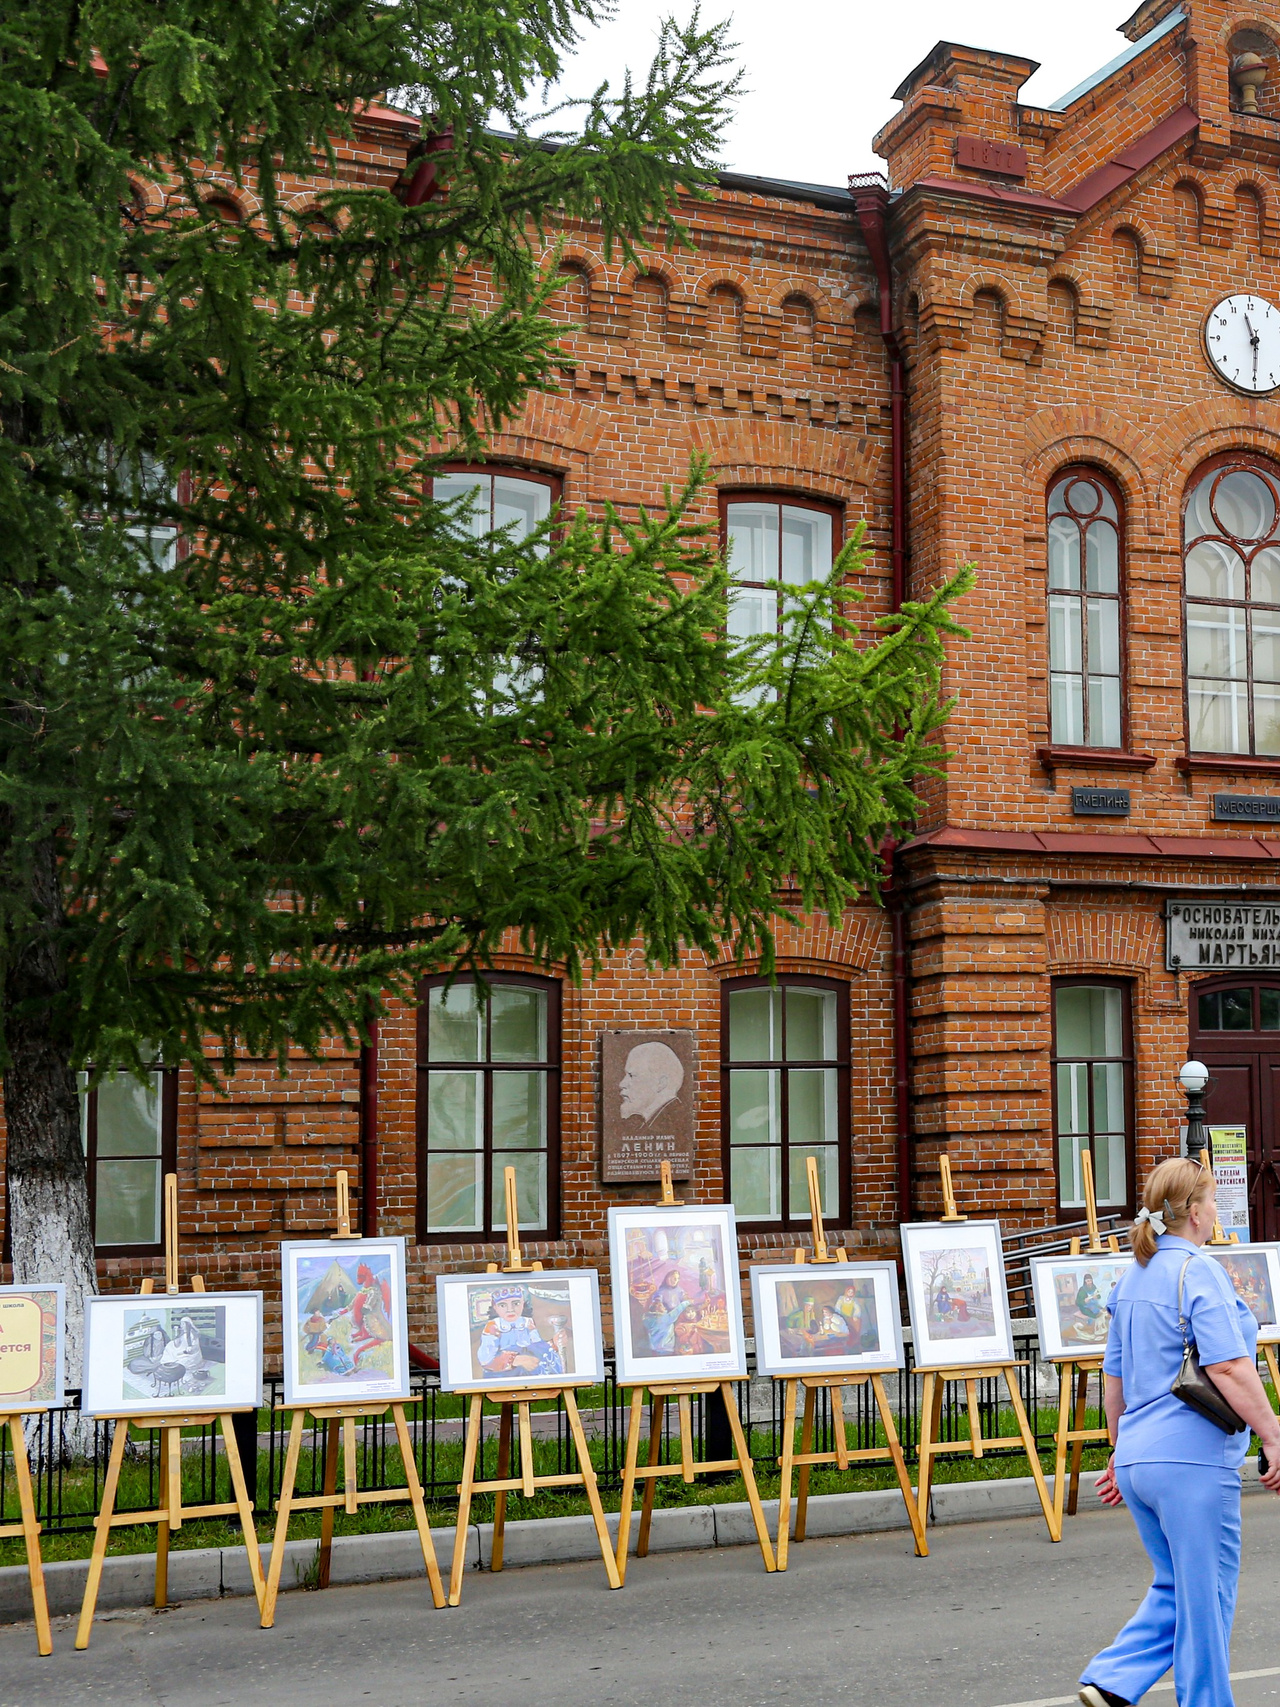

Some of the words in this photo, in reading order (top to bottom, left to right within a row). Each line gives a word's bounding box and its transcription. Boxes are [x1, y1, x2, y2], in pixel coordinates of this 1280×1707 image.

[971, 146, 1013, 169] 1877
[1182, 907, 1280, 926] ОСНОВАТЕЛЬ
[1189, 926, 1245, 940] НИКОЛАЙ
[622, 1142, 675, 1152] ЛЕНИН
